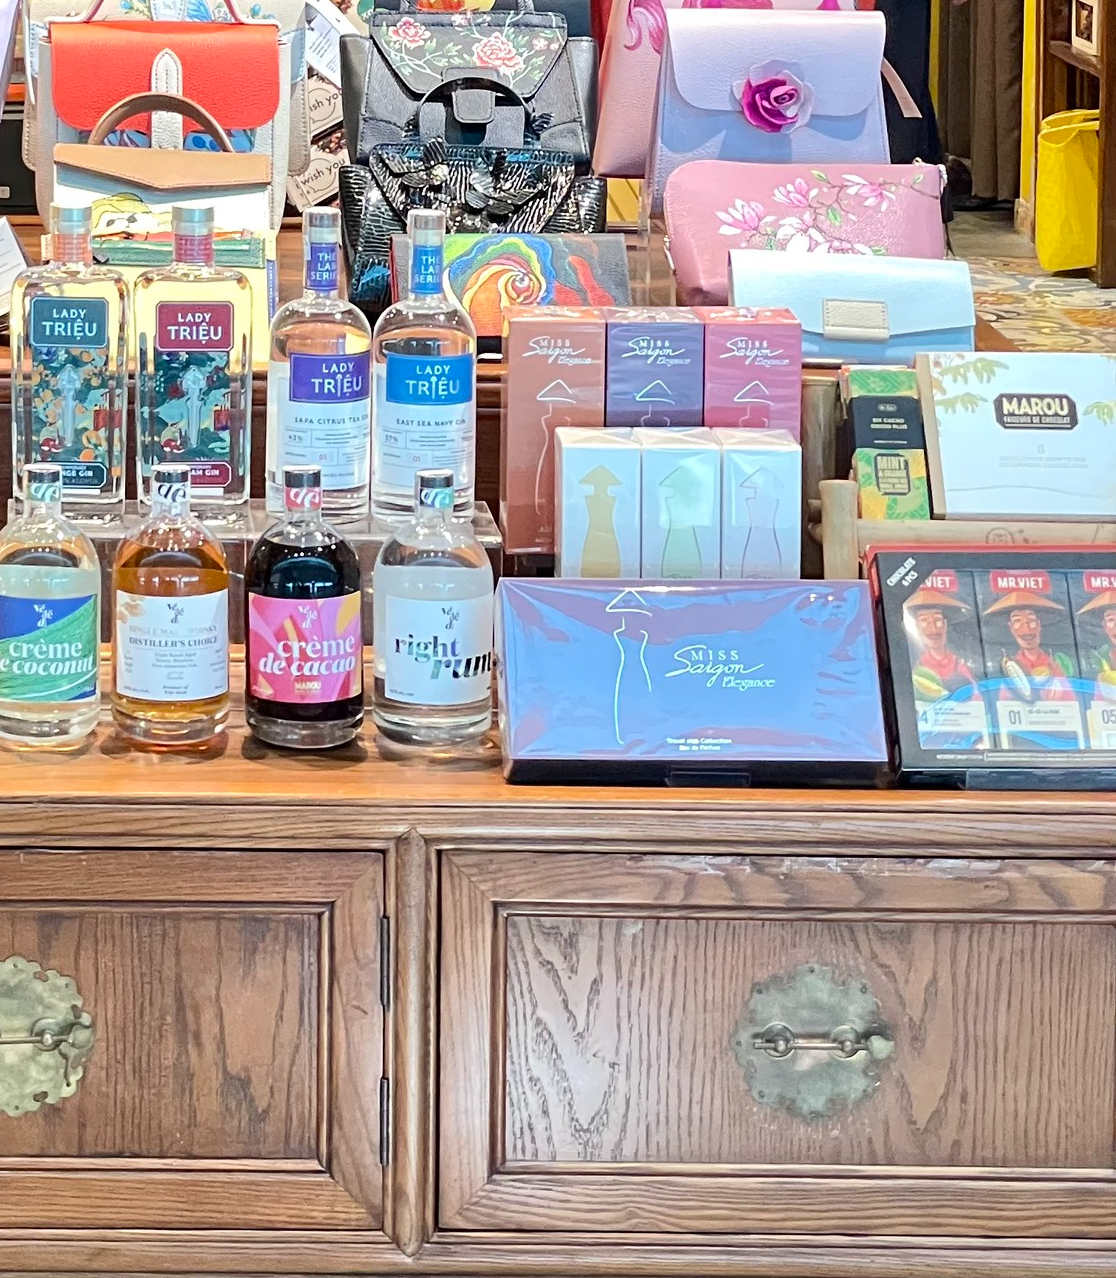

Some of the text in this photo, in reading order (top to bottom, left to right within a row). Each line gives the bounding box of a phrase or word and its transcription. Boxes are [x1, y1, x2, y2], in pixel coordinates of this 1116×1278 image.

[300, 168, 325, 186] wish
[52, 308, 86, 319] LADY
[177, 312, 212, 322] LADY
[41, 318, 97, 340] TRIỆU
[167, 322, 222, 344] TRIỆU
[522, 335, 586, 364] Saigon
[539, 339, 570, 347] MISS
[621, 336, 685, 364] Saigon
[639, 339, 670, 347] MISS
[719, 337, 784, 365] Saigon
[737, 340, 768, 348] MISS
[322, 362, 355, 373] LADY
[416, 365, 451, 375] LADY
[311, 374, 363, 397] TRIỆU
[405, 376, 460, 400] TRIỆU
[1002, 397, 1070, 416] MAROU
[294, 416, 314, 425] SAPA
[317, 417, 346, 425] CITRUS
[396, 418, 414, 426] EAST
[417, 419, 432, 427] SEA
[206, 469, 220, 477] GIN
[997, 577, 1043, 589] MR.VIET
[9, 638, 83, 659] crème
[187, 635, 218, 648] CHOICE
[277, 635, 356, 658] crème
[395, 633, 461, 664] right
[690, 649, 739, 661] MISS
[12, 654, 94, 676] coconut
[259, 652, 357, 676] de cacao
[430, 651, 492, 680] rum
[664, 644, 765, 688] Saigon
[294, 680, 322, 690] MAROU
[721, 675, 777, 692] Elegance
[1008, 710, 1022, 725] 01
